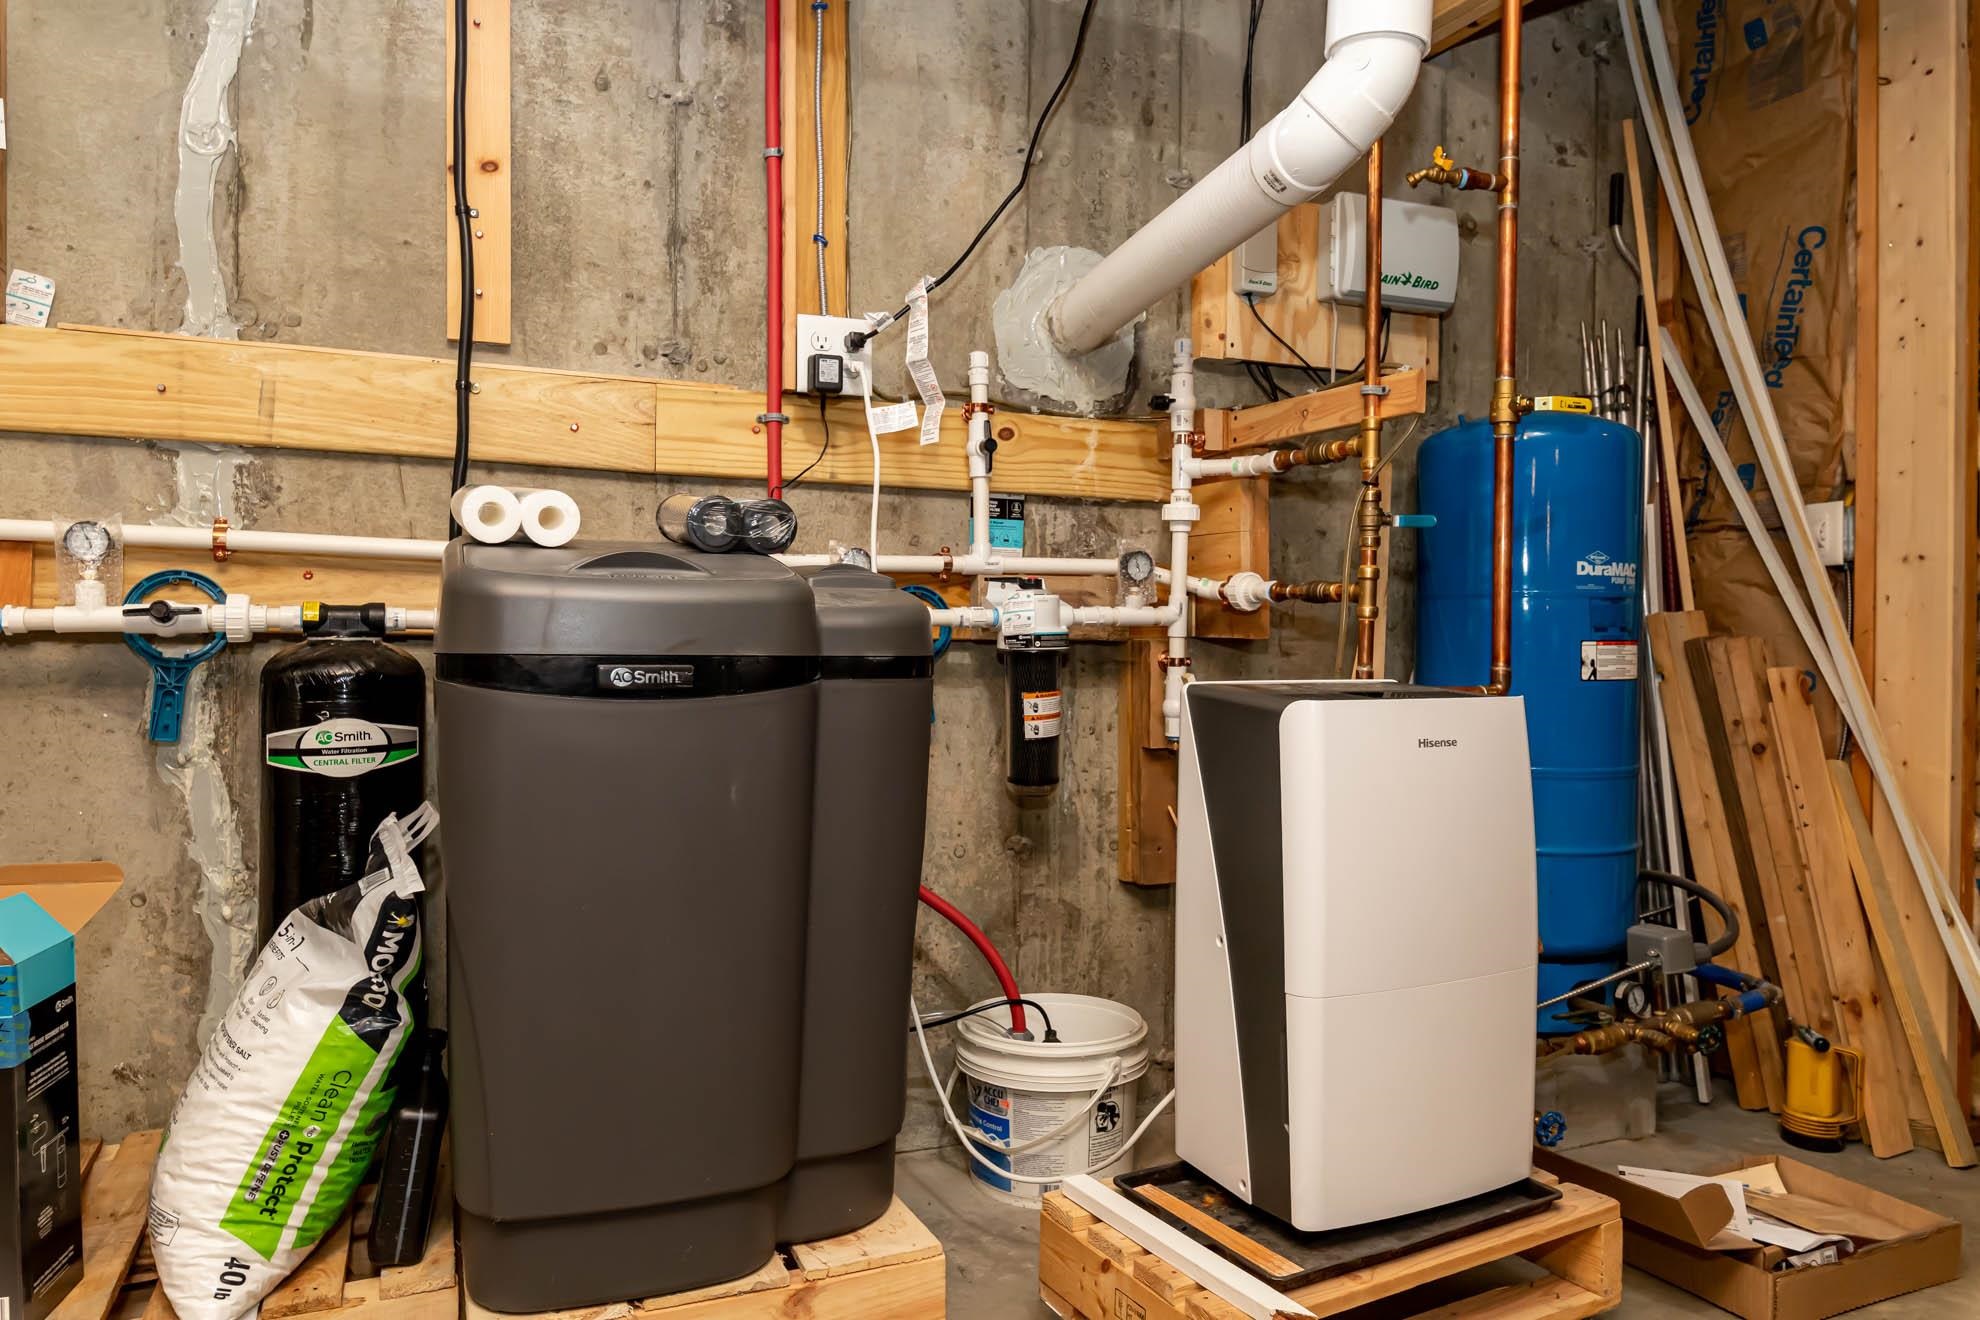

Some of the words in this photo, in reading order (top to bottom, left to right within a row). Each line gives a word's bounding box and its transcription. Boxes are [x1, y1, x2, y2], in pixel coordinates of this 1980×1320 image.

[1380, 273, 1401, 286] AIN
[1411, 275, 1439, 290] BIRD
[1764, 225, 1827, 389] CertainTeed
[1576, 560, 1637, 577] DuraMAC
[634, 670, 679, 684] Smith
[334, 731, 372, 742] Smith
[1418, 738, 1457, 748] Hisense
[313, 758, 349, 766] CENTRAL
[352, 756, 376, 765] FILTER
[236, 1046, 252, 1061] SALT
[310, 1070, 352, 1122] Clean
[259, 1140, 314, 1217] Protect
[220, 1256, 251, 1287] 40
[213, 1287, 233, 1301] lb
